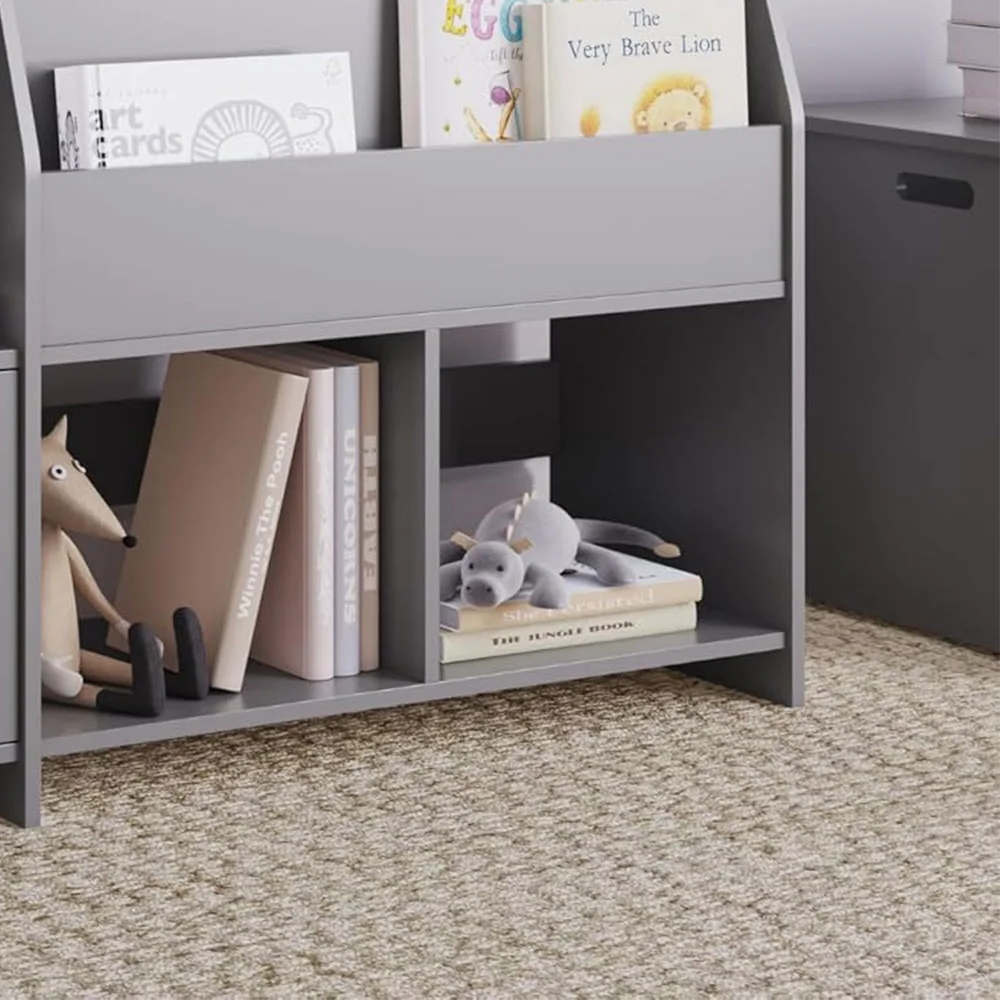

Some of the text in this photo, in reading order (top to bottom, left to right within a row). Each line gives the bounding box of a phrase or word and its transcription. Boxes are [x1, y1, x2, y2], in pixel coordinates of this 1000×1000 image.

[629, 9, 661, 28] The
[567, 34, 722, 65] Very Brave Lion
[88, 101, 144, 131] art
[92, 126, 183, 160] cards
[236, 431, 290, 619] Winnie The Pooh
[343, 428, 357, 625] UNICORNS
[491, 620, 636, 647] THE JUNGLE BOOK
